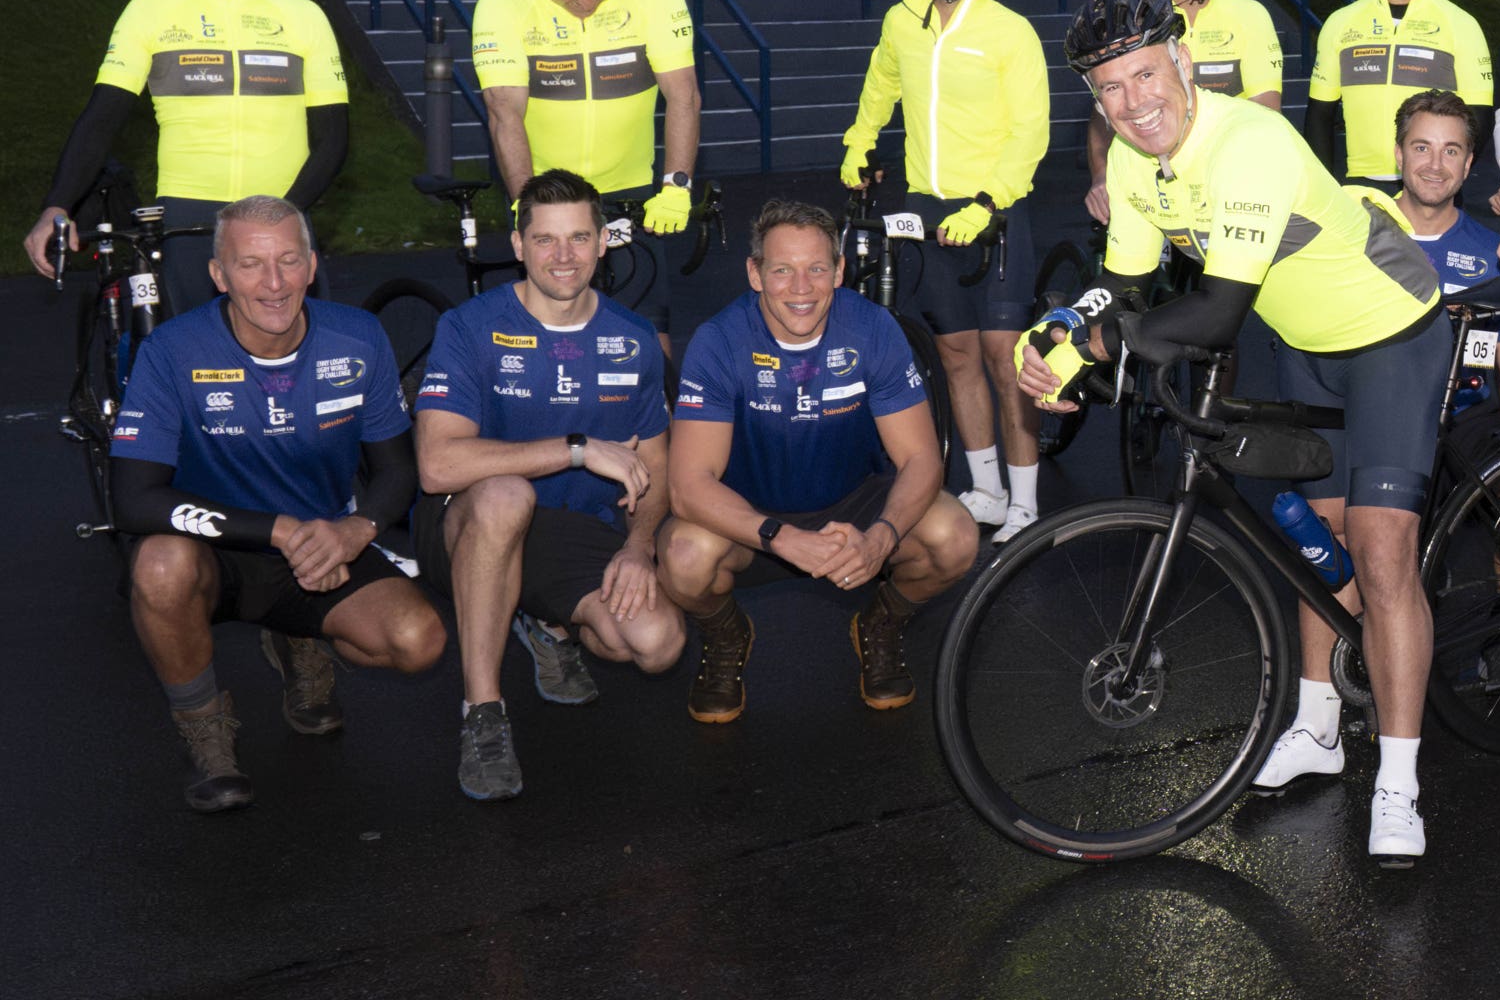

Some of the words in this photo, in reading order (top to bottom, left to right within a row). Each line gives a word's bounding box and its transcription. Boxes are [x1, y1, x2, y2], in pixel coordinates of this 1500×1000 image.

[672, 26, 692, 38] YET
[1224, 201, 1270, 213] LOGAN
[896, 220, 915, 232] 08
[1223, 225, 1265, 244] YETI
[137, 282, 158, 298] 35
[494, 335, 515, 346] Arnold
[1473, 341, 1489, 359] 05
[316, 360, 330, 368] ENNY
[329, 357, 350, 366] LOGAN'S
[316, 366, 330, 374] UGBY
[330, 363, 348, 371] WORLD
[324, 368, 351, 379] CHALLENGE
[195, 371, 219, 381] Arnold
[219, 371, 241, 381] Clark
[822, 401, 861, 416] Sainsbury's
[114, 427, 140, 437] AF
[225, 425, 245, 436] BULL
